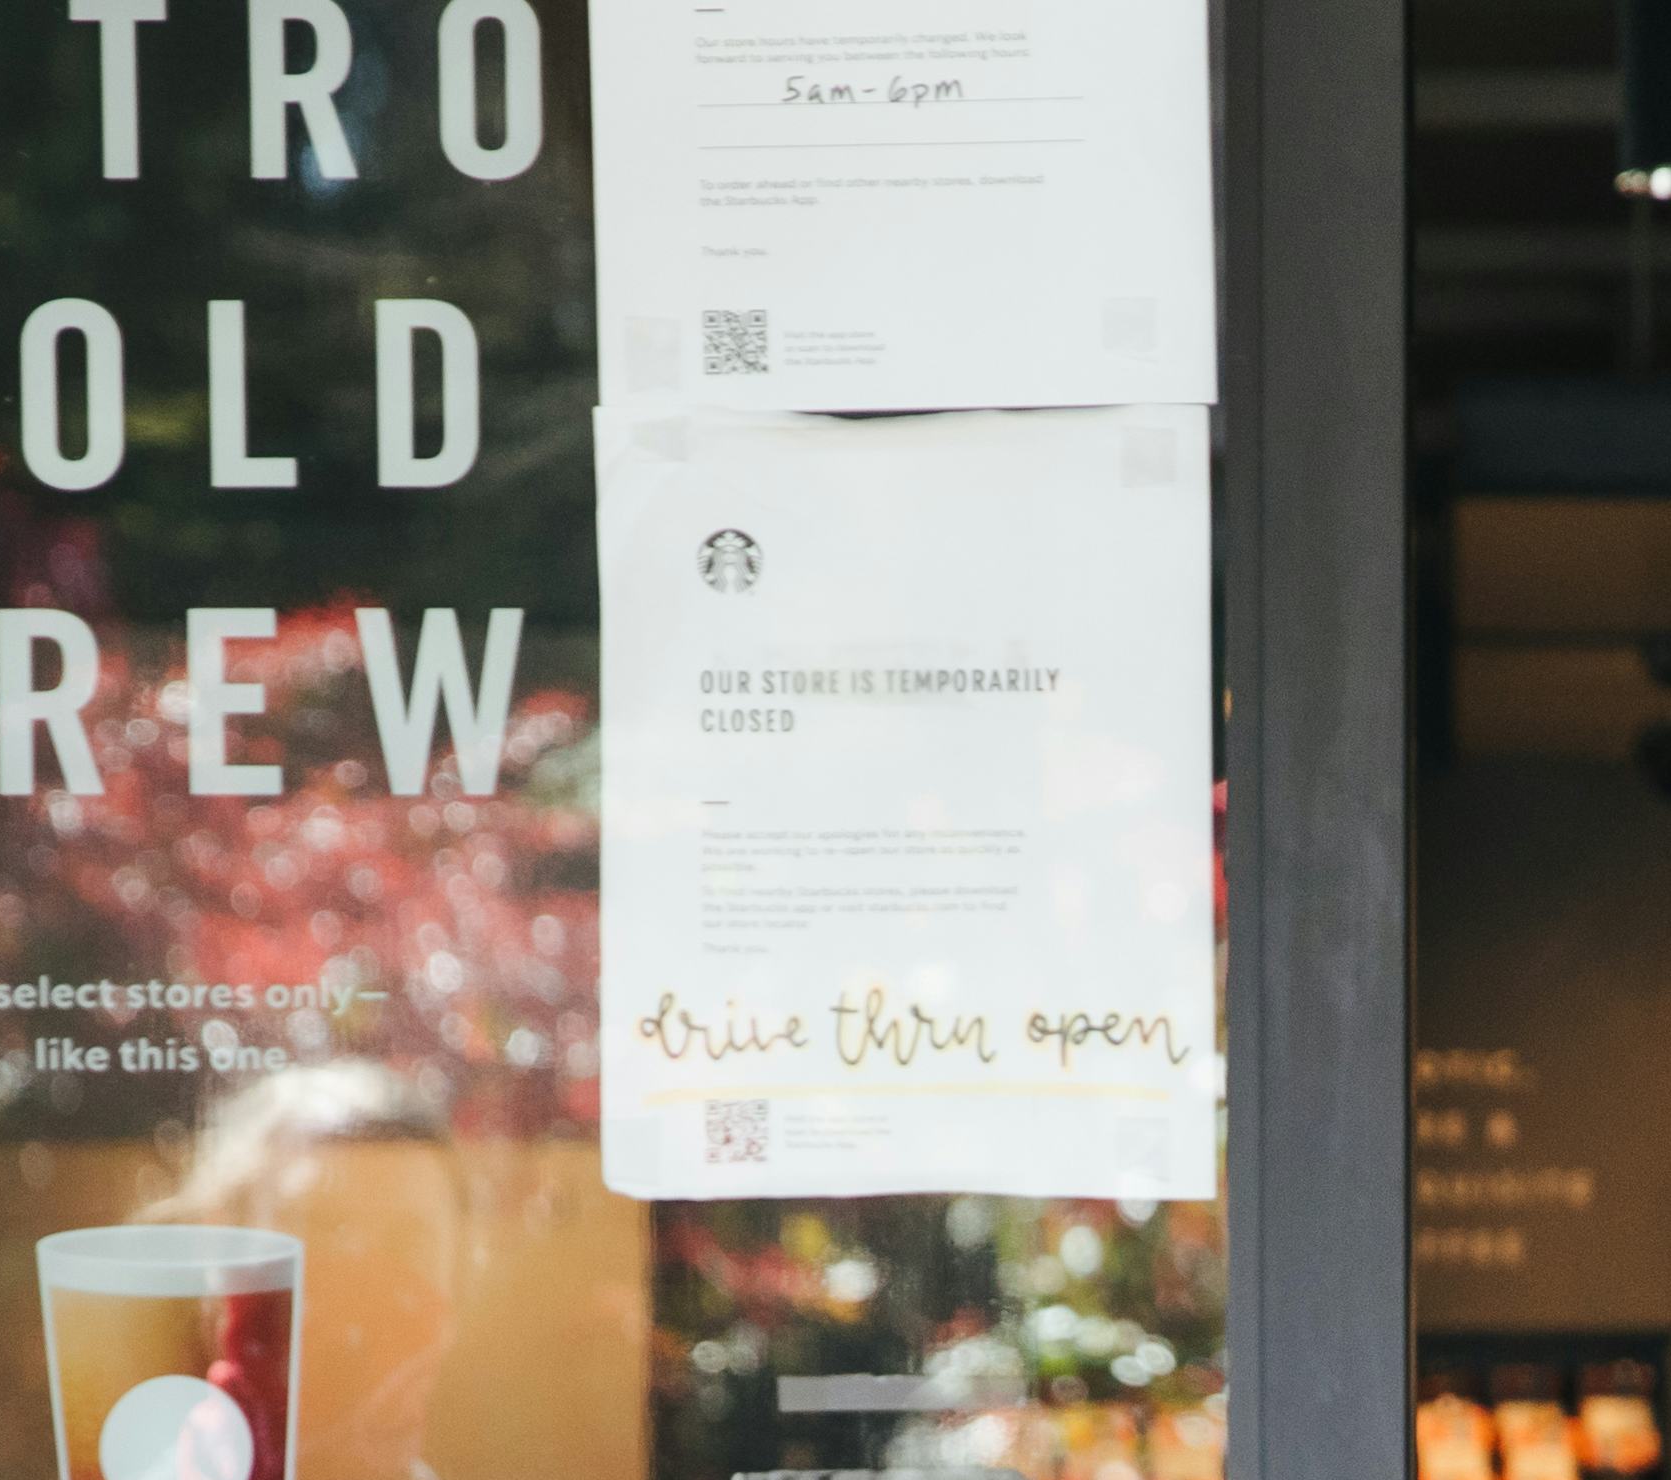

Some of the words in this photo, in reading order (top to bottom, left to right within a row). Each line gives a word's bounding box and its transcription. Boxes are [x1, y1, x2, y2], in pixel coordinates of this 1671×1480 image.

[700, 669, 751, 694] OUR
[762, 669, 841, 694] STORE
[850, 669, 875, 694] IS
[883, 668, 1061, 694] TEMPORARILY
[700, 708, 796, 733] CLOSED
[128, 980, 255, 1009] stores
[640, 992, 809, 1061] drive
[830, 988, 996, 1066] thru
[1028, 1011, 1190, 1068] open
[35, 1039, 109, 1072] like
[119, 1039, 198, 1072] this
